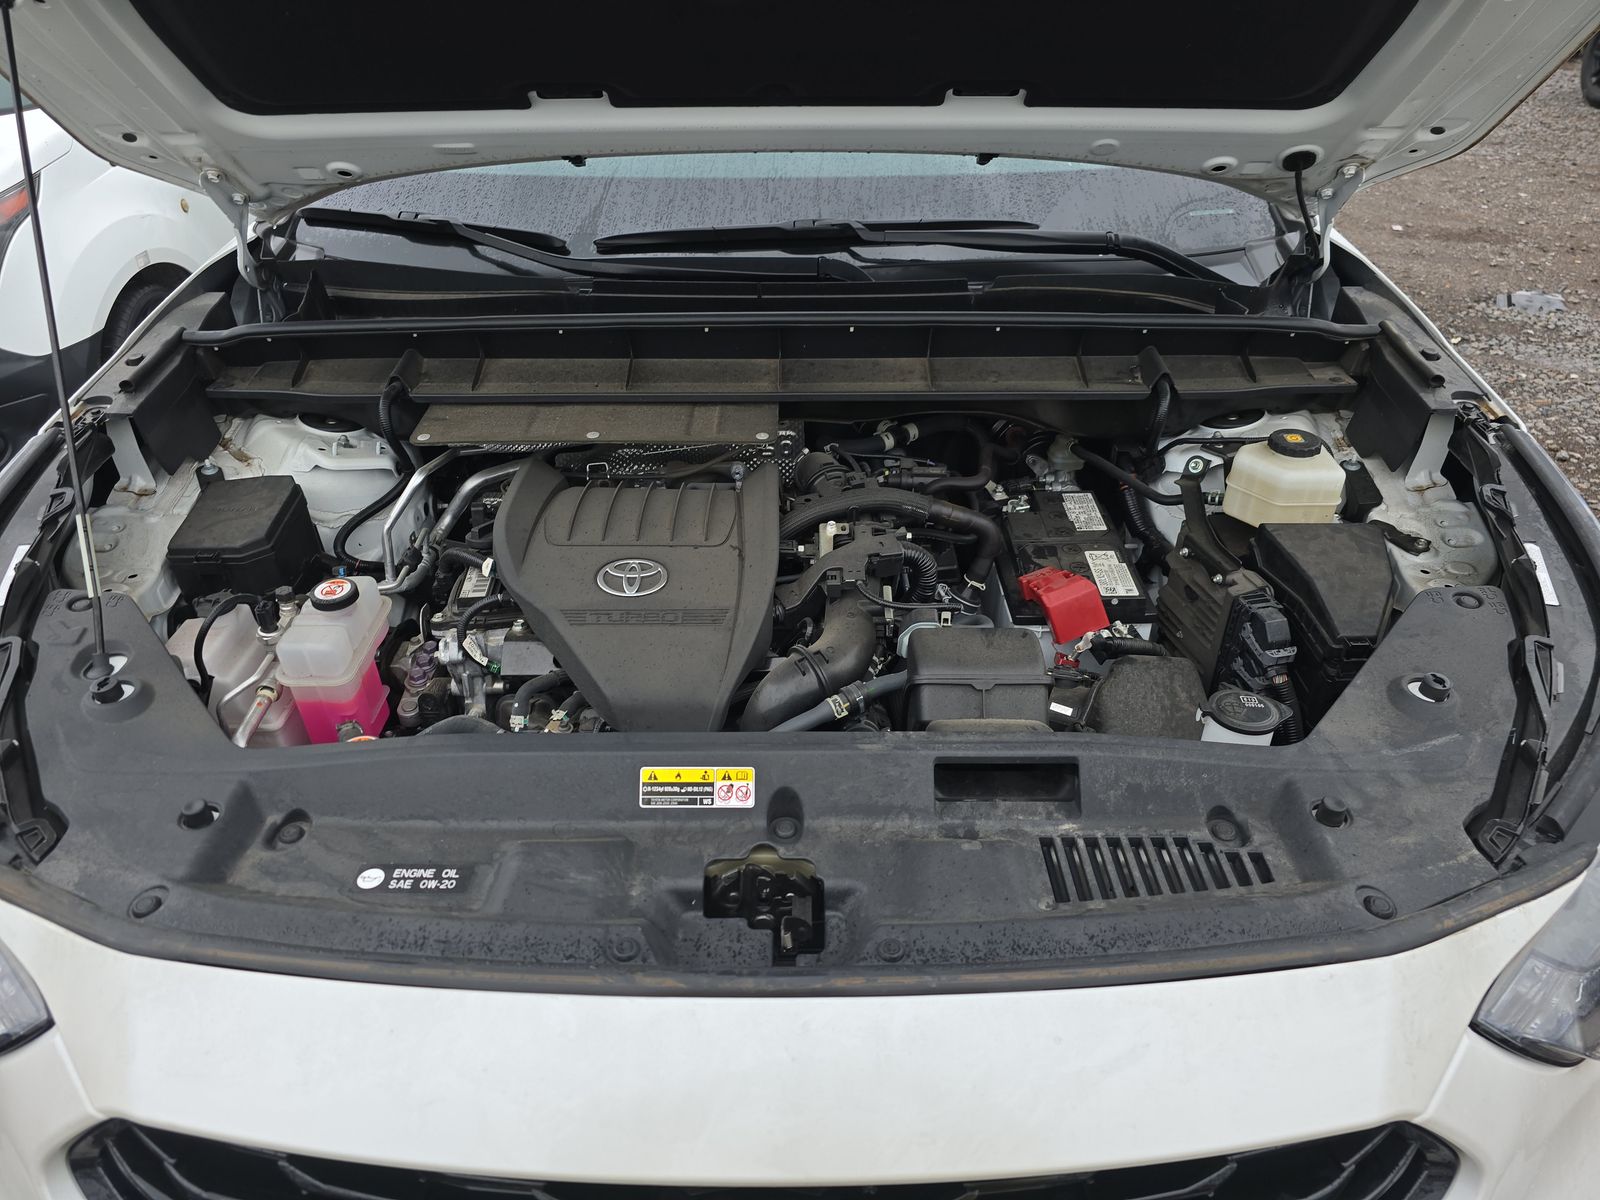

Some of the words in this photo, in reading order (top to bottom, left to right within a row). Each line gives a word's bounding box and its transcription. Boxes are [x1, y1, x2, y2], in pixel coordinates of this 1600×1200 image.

[589, 611, 682, 623] TURBO
[392, 868, 436, 878] ENGINE
[441, 868, 460, 878] OIL
[388, 879, 414, 889] SAE
[419, 879, 457, 889] 0W-20
